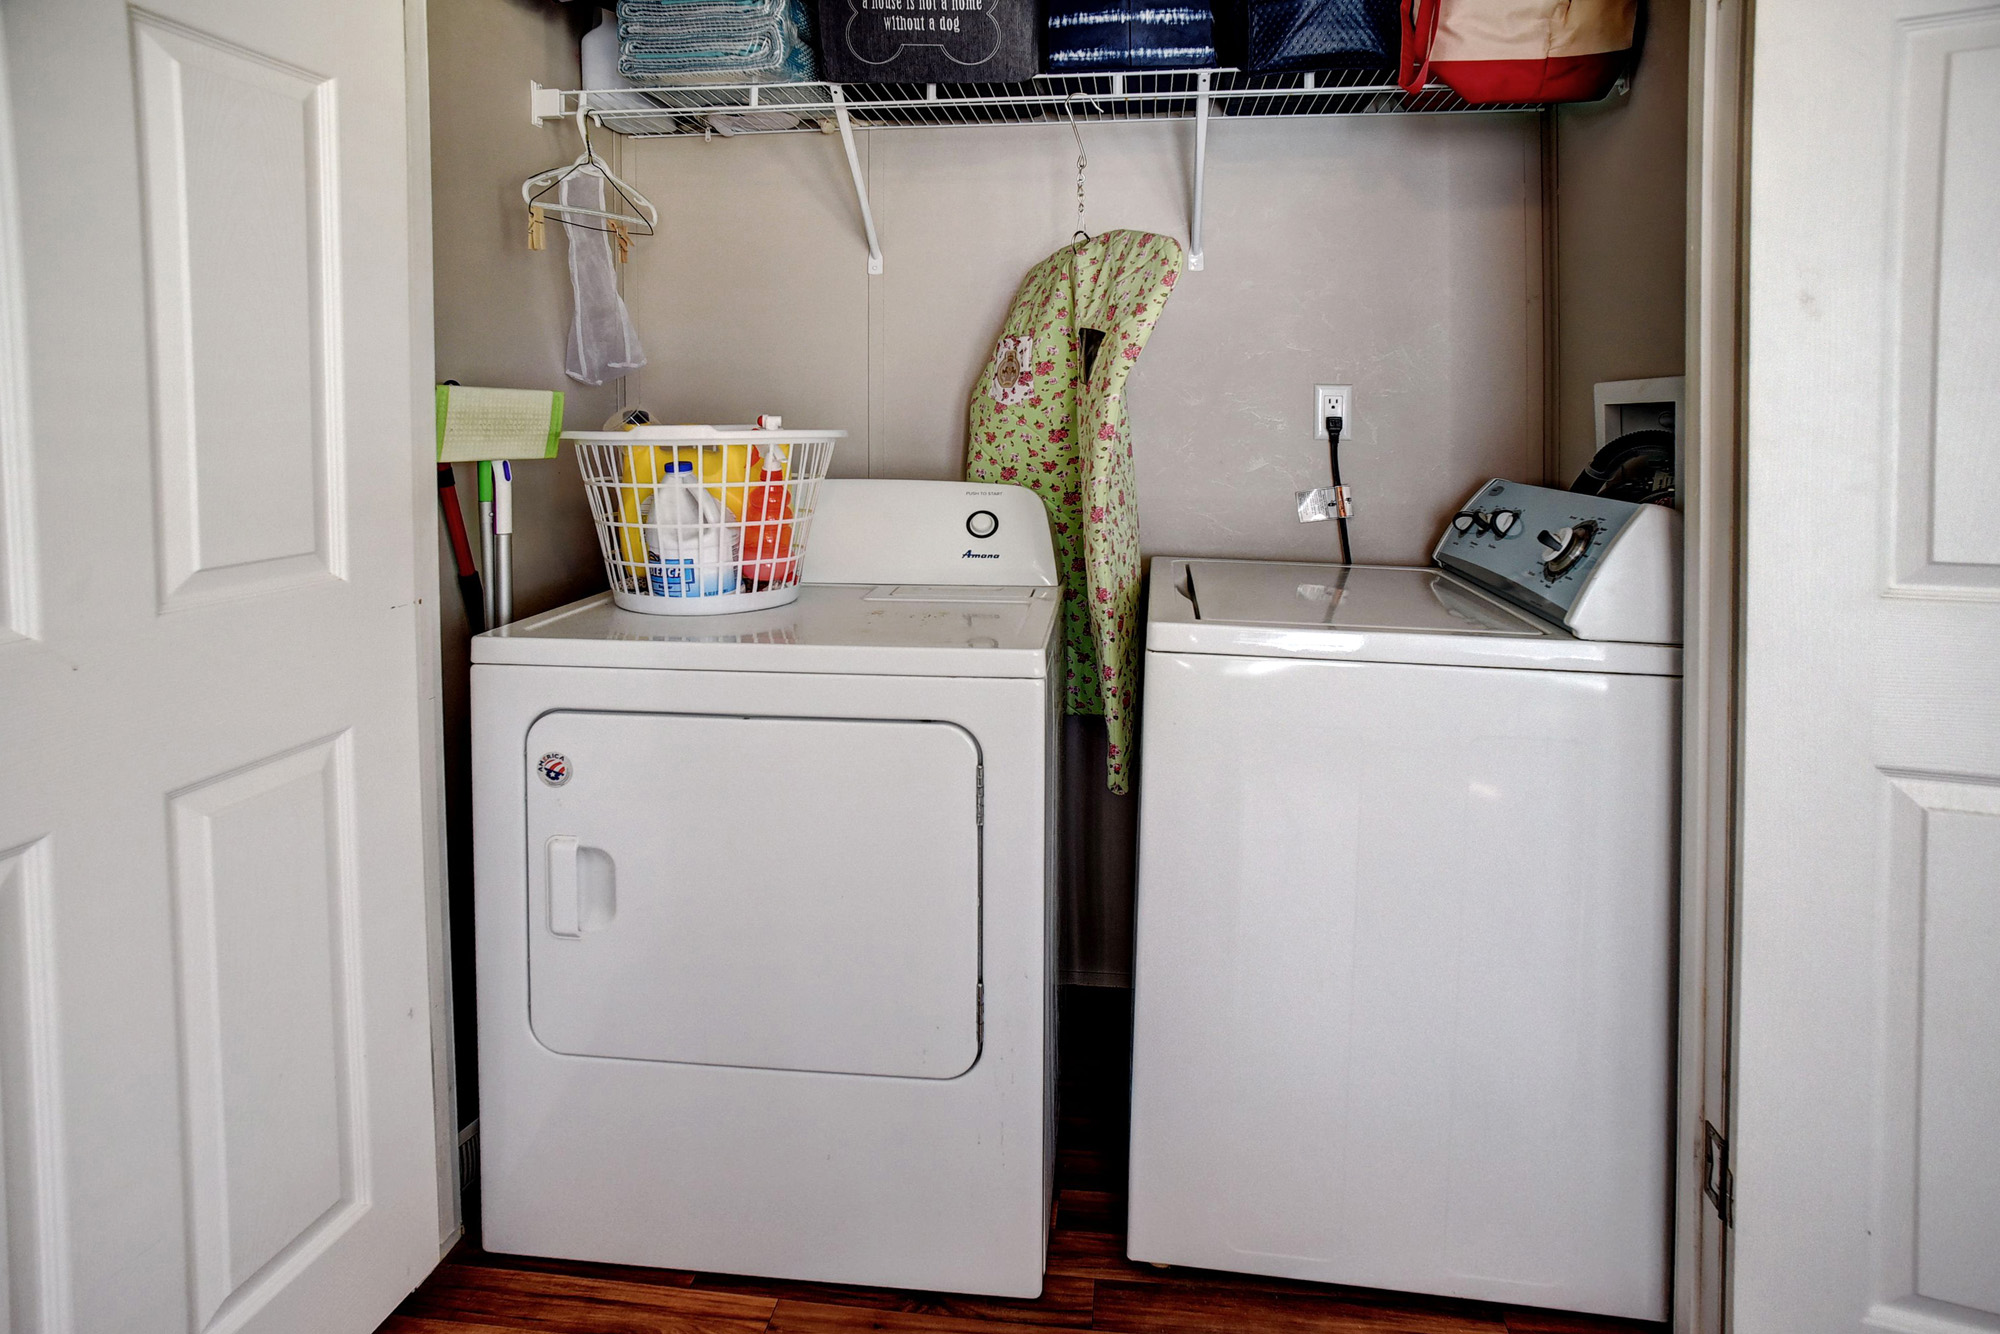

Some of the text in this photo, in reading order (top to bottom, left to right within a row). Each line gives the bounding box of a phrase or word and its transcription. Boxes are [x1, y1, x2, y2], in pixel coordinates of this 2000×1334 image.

[862, 0, 982, 10] a house is not a home
[883, 15, 960, 33] without a dog
[962, 549, 1000, 559] Amana
[649, 566, 682, 578] LECH
[538, 753, 564, 772] AMERICA
